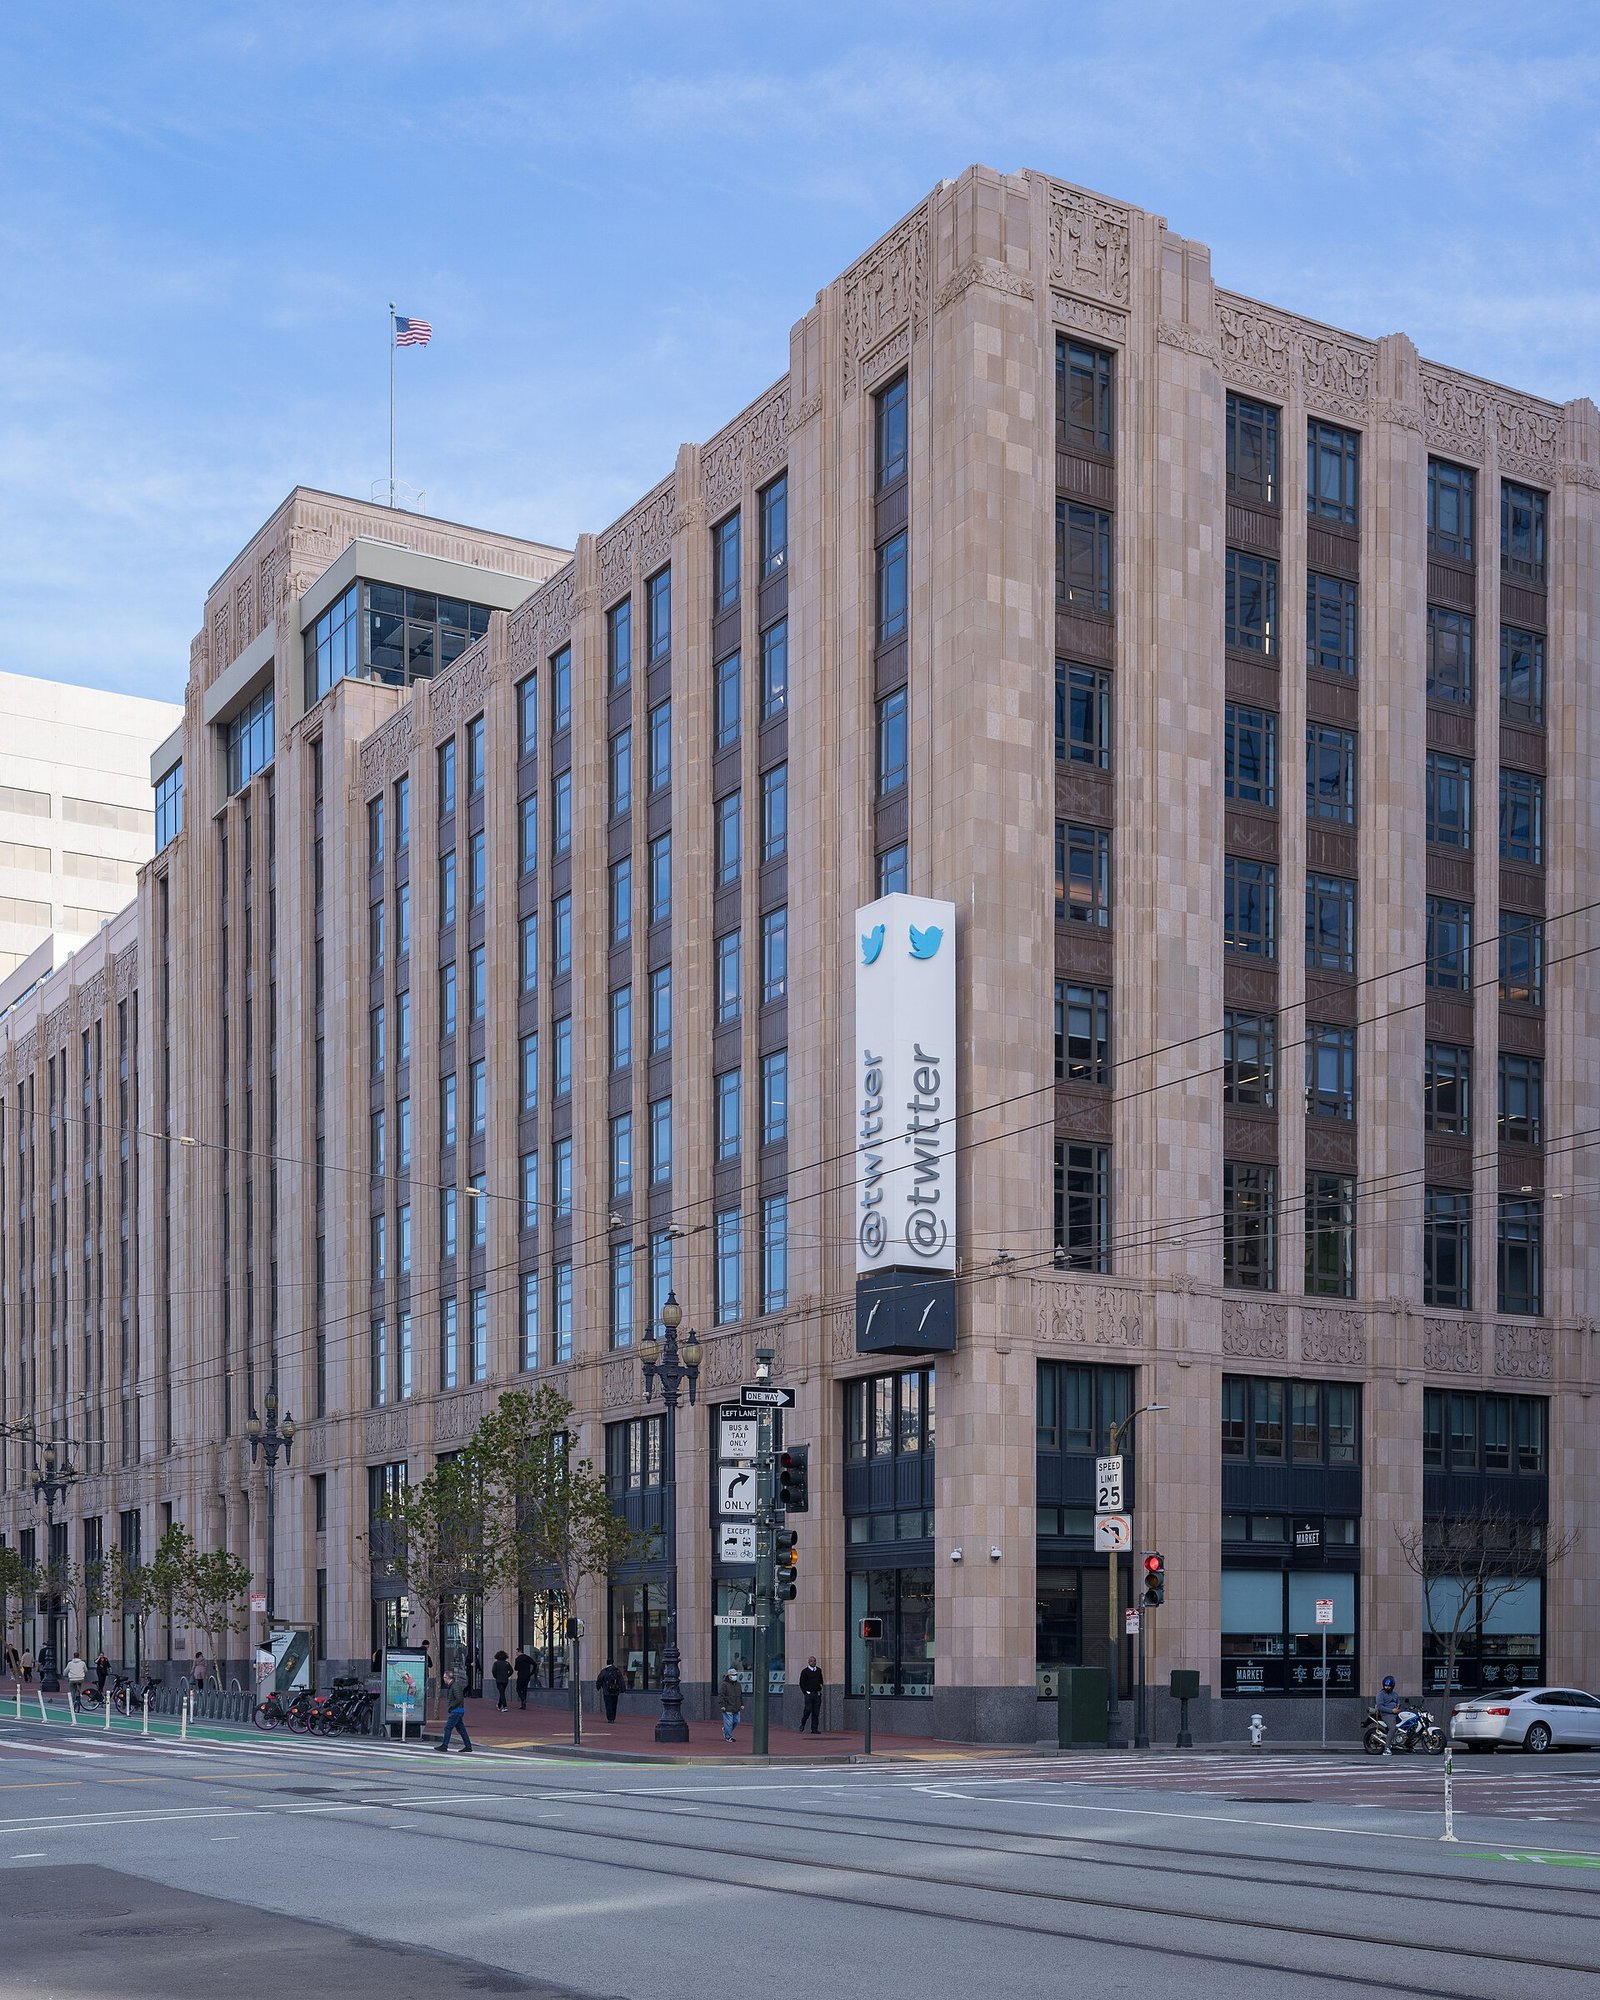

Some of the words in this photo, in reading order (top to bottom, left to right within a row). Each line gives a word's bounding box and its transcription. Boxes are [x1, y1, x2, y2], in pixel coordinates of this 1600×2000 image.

[860, 1049, 888, 1258] @twitter
[905, 1043, 947, 1258] @twitter
[747, 1392, 762, 1400] ONE
[764, 1393, 779, 1401] WAY
[1098, 1461, 1121, 1472] SPEED
[1100, 1474, 1119, 1484] LIMIT
[1099, 1486, 1120, 1507] 25
[724, 1500, 752, 1510] ONLY
[727, 1527, 751, 1535] EXCEPT
[1296, 1532, 1320, 1544] MARKET
[1236, 1669, 1264, 1680] MARKET
[1434, 1668, 1459, 1679] MARET
